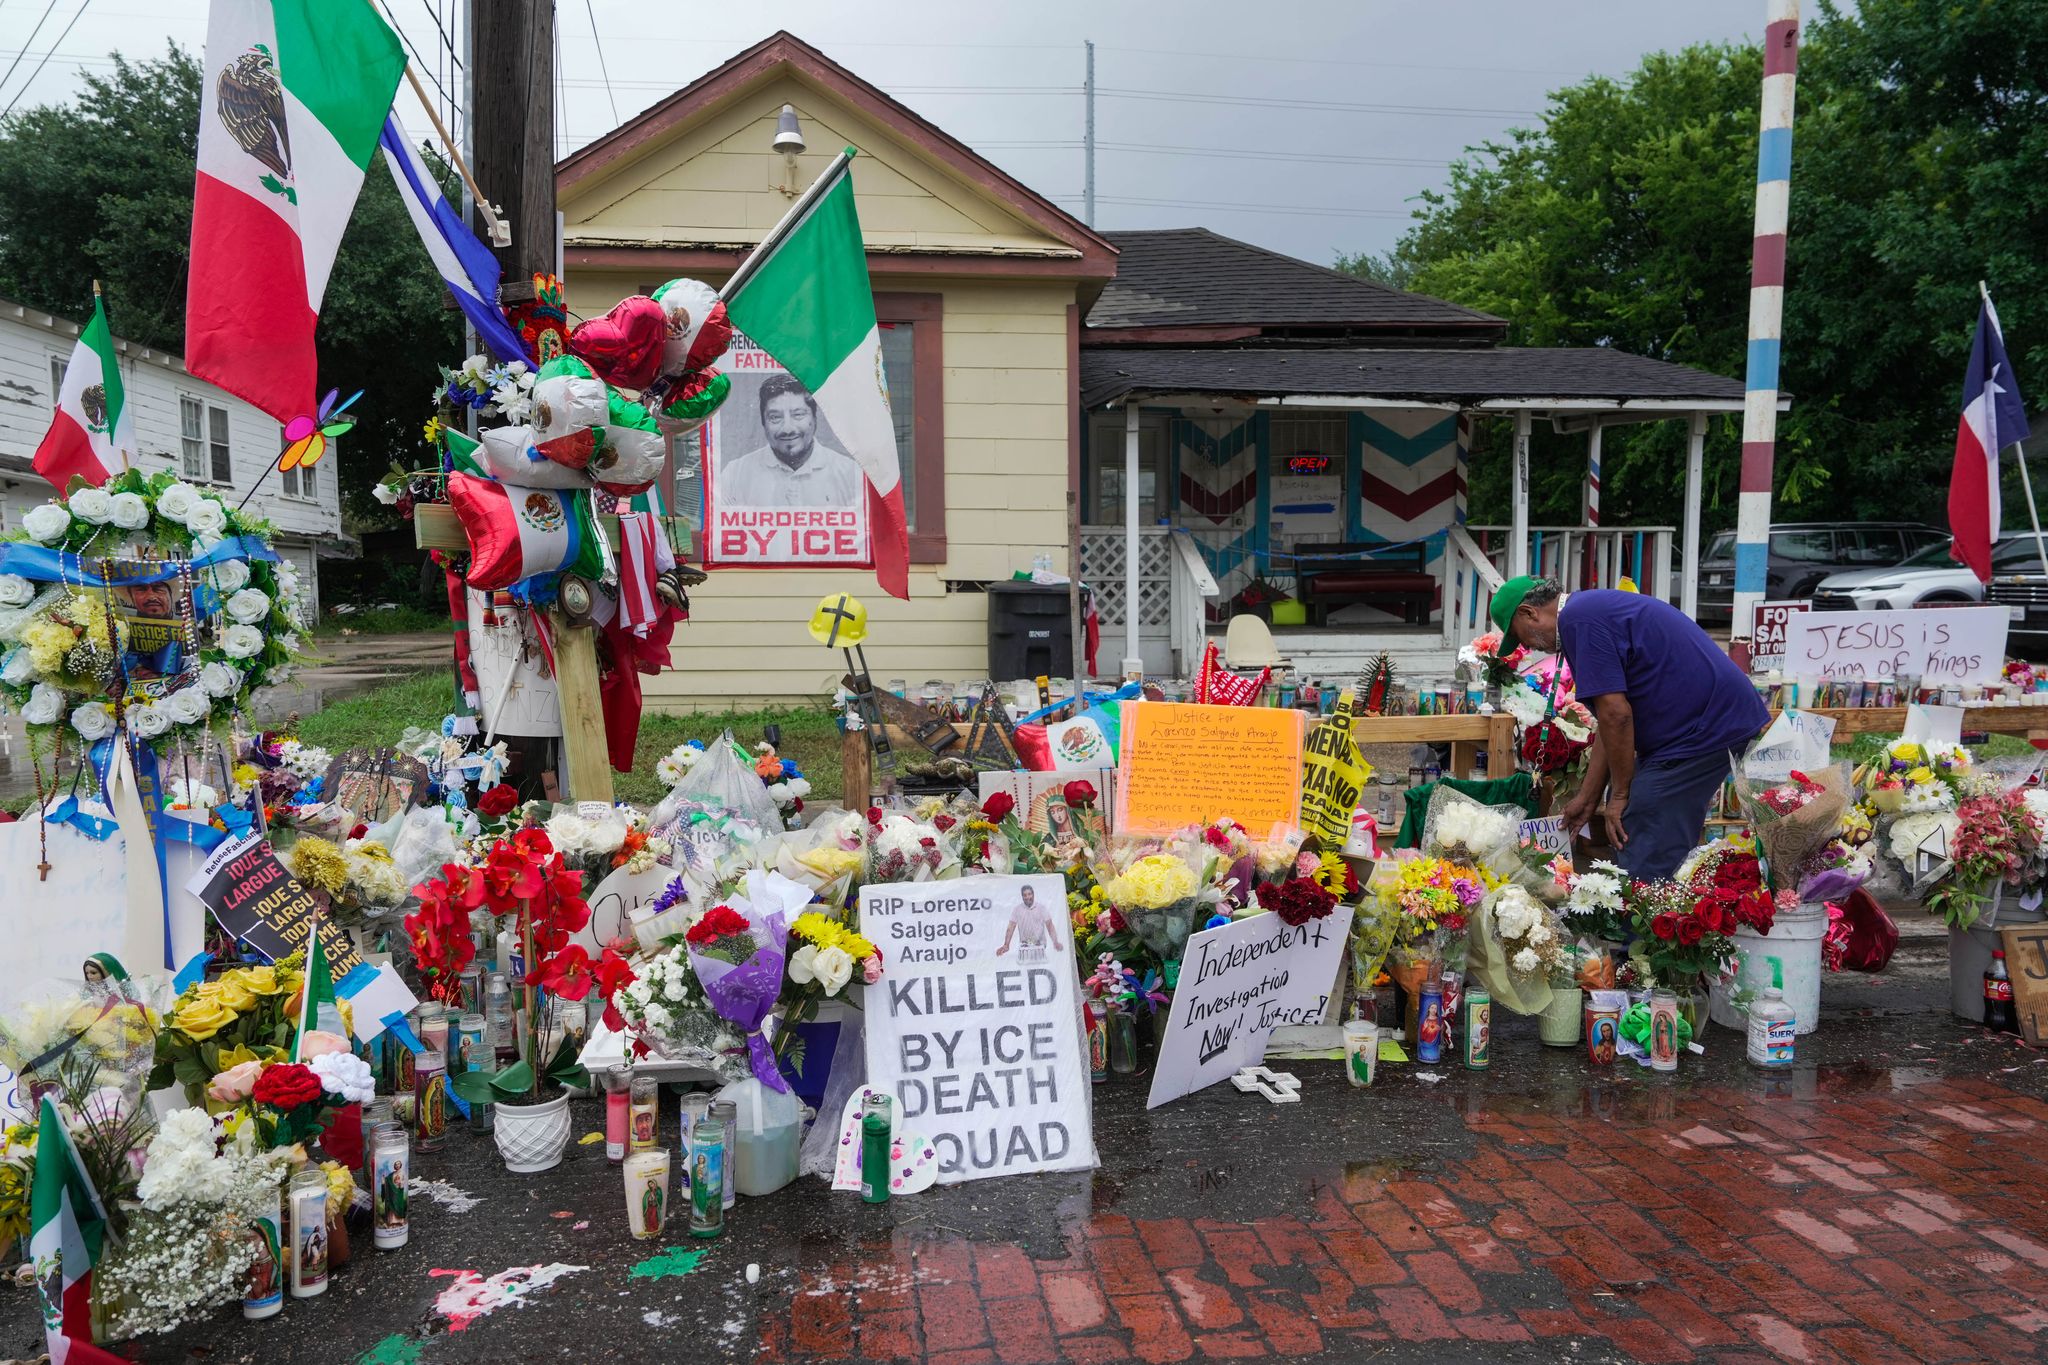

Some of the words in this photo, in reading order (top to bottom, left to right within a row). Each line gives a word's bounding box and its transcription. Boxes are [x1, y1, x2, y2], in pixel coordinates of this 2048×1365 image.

[736, 353, 784, 368] FATH
[1290, 458, 1328, 468] OPEN
[720, 512, 856, 526] MURDERED
[721, 530, 777, 556] BY
[791, 530, 858, 556] ICE
[130, 624, 169, 640] USTICE
[1806, 622, 1904, 660] JESUS
[1760, 643, 1771, 654] BY
[1926, 650, 1982, 678] Kings
[1155, 704, 1210, 725] Justice
[1150, 721, 1196, 737] Lorenzo
[1332, 776, 1358, 808] NO
[224, 862, 283, 910] LARGUE
[266, 892, 314, 932] LARGU
[869, 898, 904, 916] RIP
[912, 898, 992, 914] Lorenzo
[890, 920, 974, 942] Salgado
[900, 945, 968, 964] Araujo
[1194, 924, 1329, 986] Independent
[888, 968, 1058, 1018] KILLED
[1184, 968, 1289, 1030] Investigation
[901, 1030, 964, 1074] BY
[980, 1022, 1057, 1066] ICE
[897, 1065, 1058, 1118] DEATH
[932, 1122, 1070, 1174] QUAD
